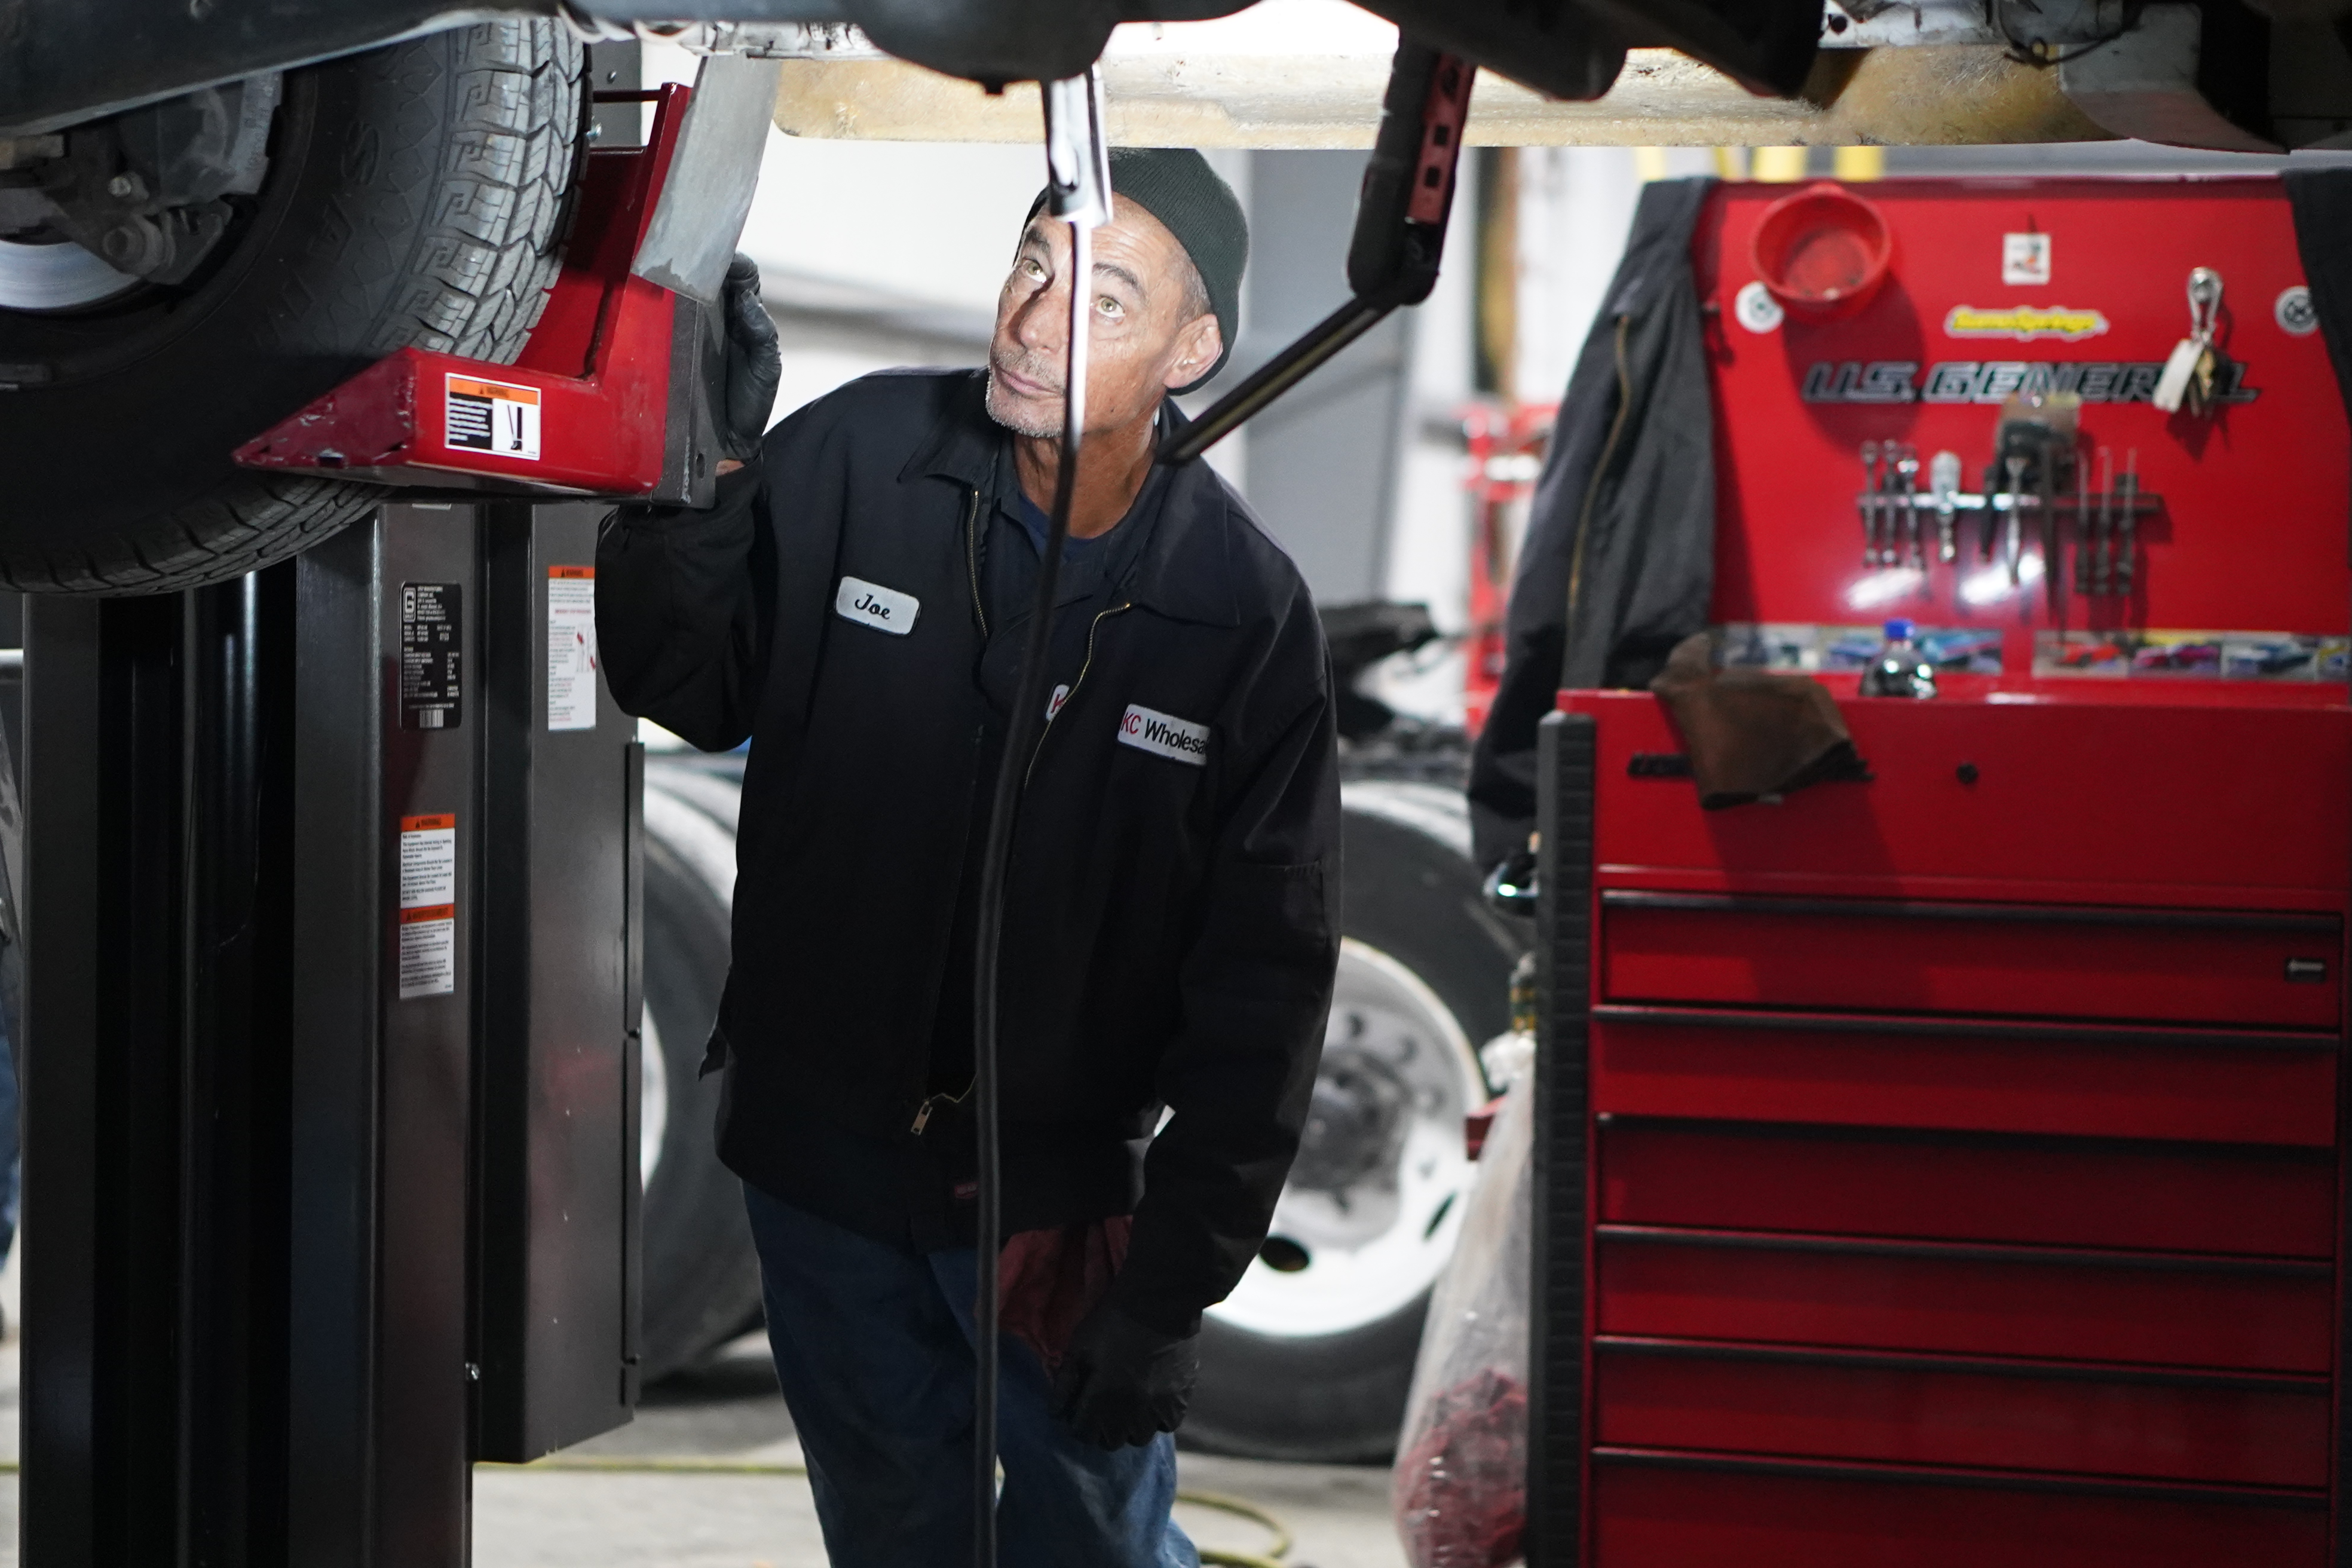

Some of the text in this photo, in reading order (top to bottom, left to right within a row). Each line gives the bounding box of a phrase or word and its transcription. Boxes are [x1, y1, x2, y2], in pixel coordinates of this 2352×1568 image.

[1922, 361, 2261, 405] GENERL
[855, 593, 890, 620] Joe
[1121, 712, 1141, 734] KC
